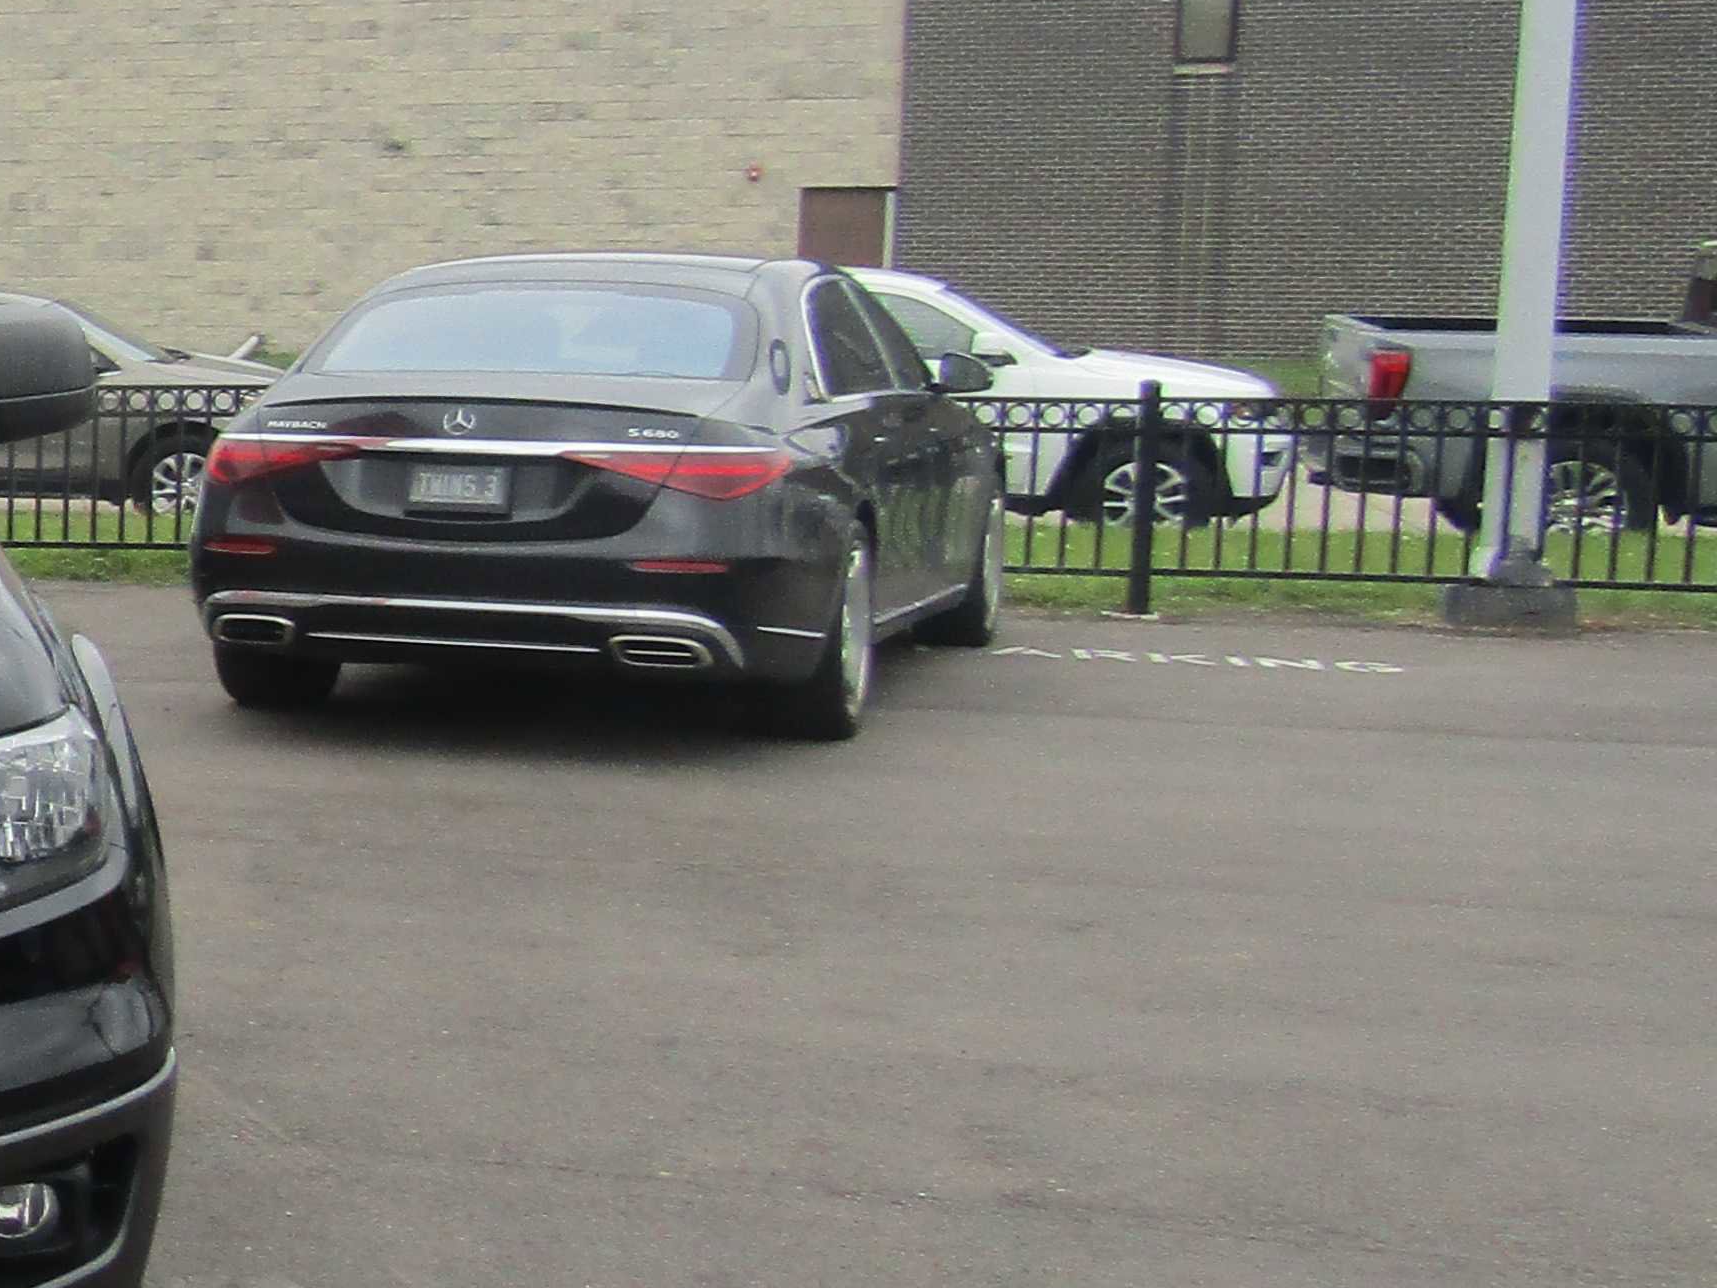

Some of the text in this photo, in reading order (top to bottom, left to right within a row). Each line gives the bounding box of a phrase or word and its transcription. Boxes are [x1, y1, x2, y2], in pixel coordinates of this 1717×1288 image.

[267, 419, 328, 430] MAYBACH
[628, 427, 641, 437] S
[990, 645, 1407, 674] ARKING
